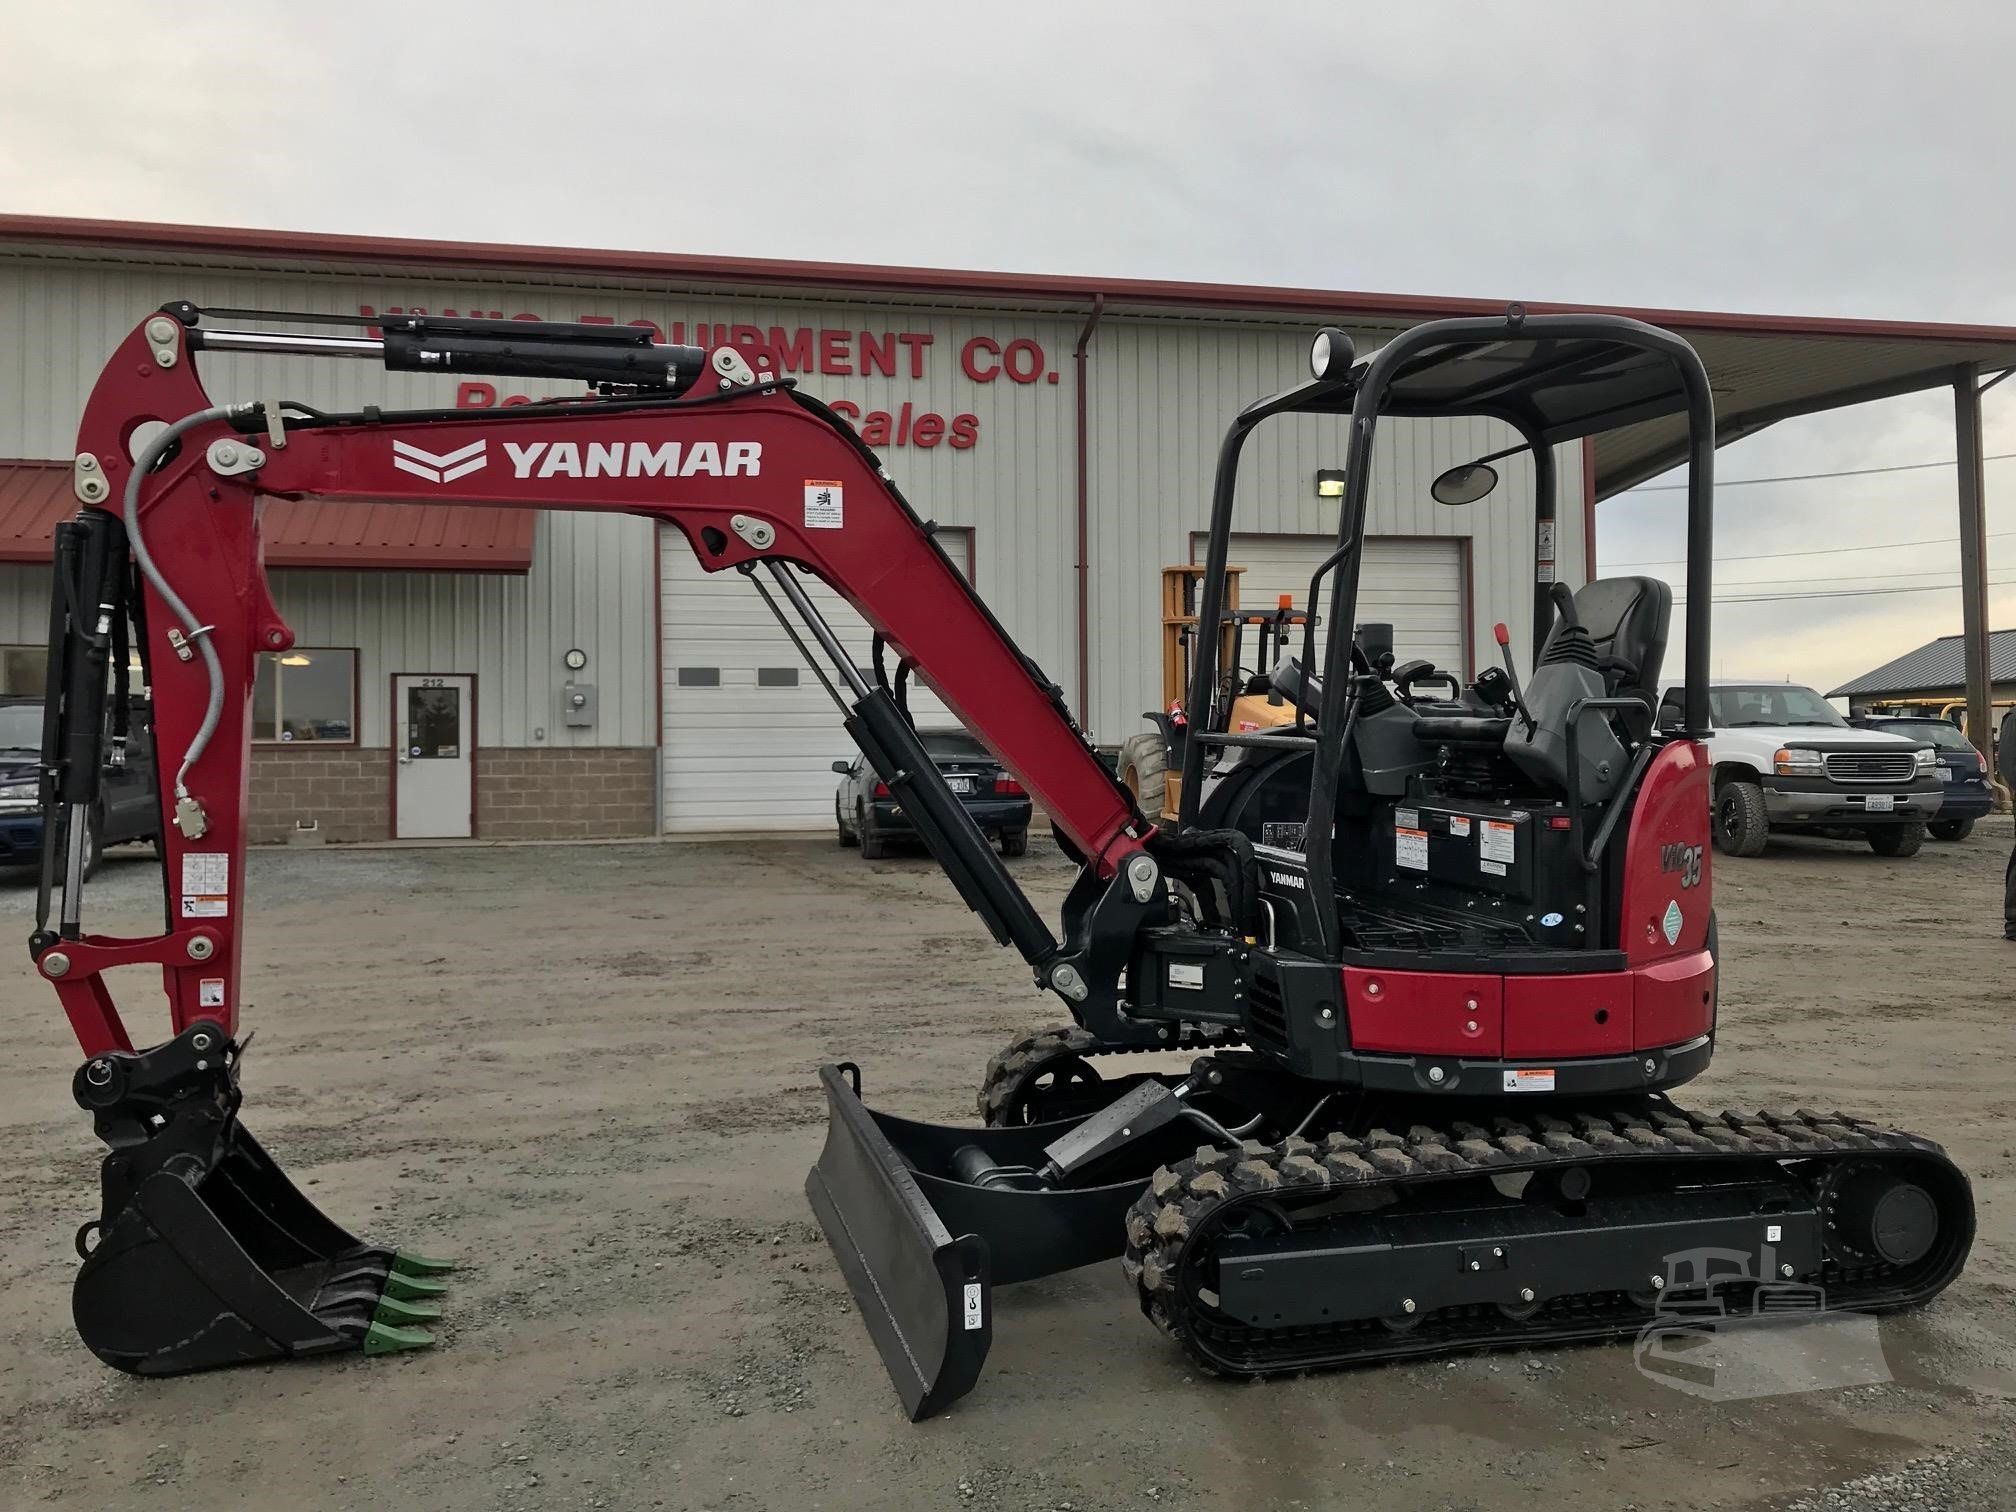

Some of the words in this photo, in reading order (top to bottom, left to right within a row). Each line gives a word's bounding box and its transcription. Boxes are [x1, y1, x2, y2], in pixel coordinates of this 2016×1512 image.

[961, 336, 1059, 385] CO.
[503, 441, 763, 479] YANMAR
[422, 678, 445, 688] 212
[1270, 870, 1305, 890] YANMAR
